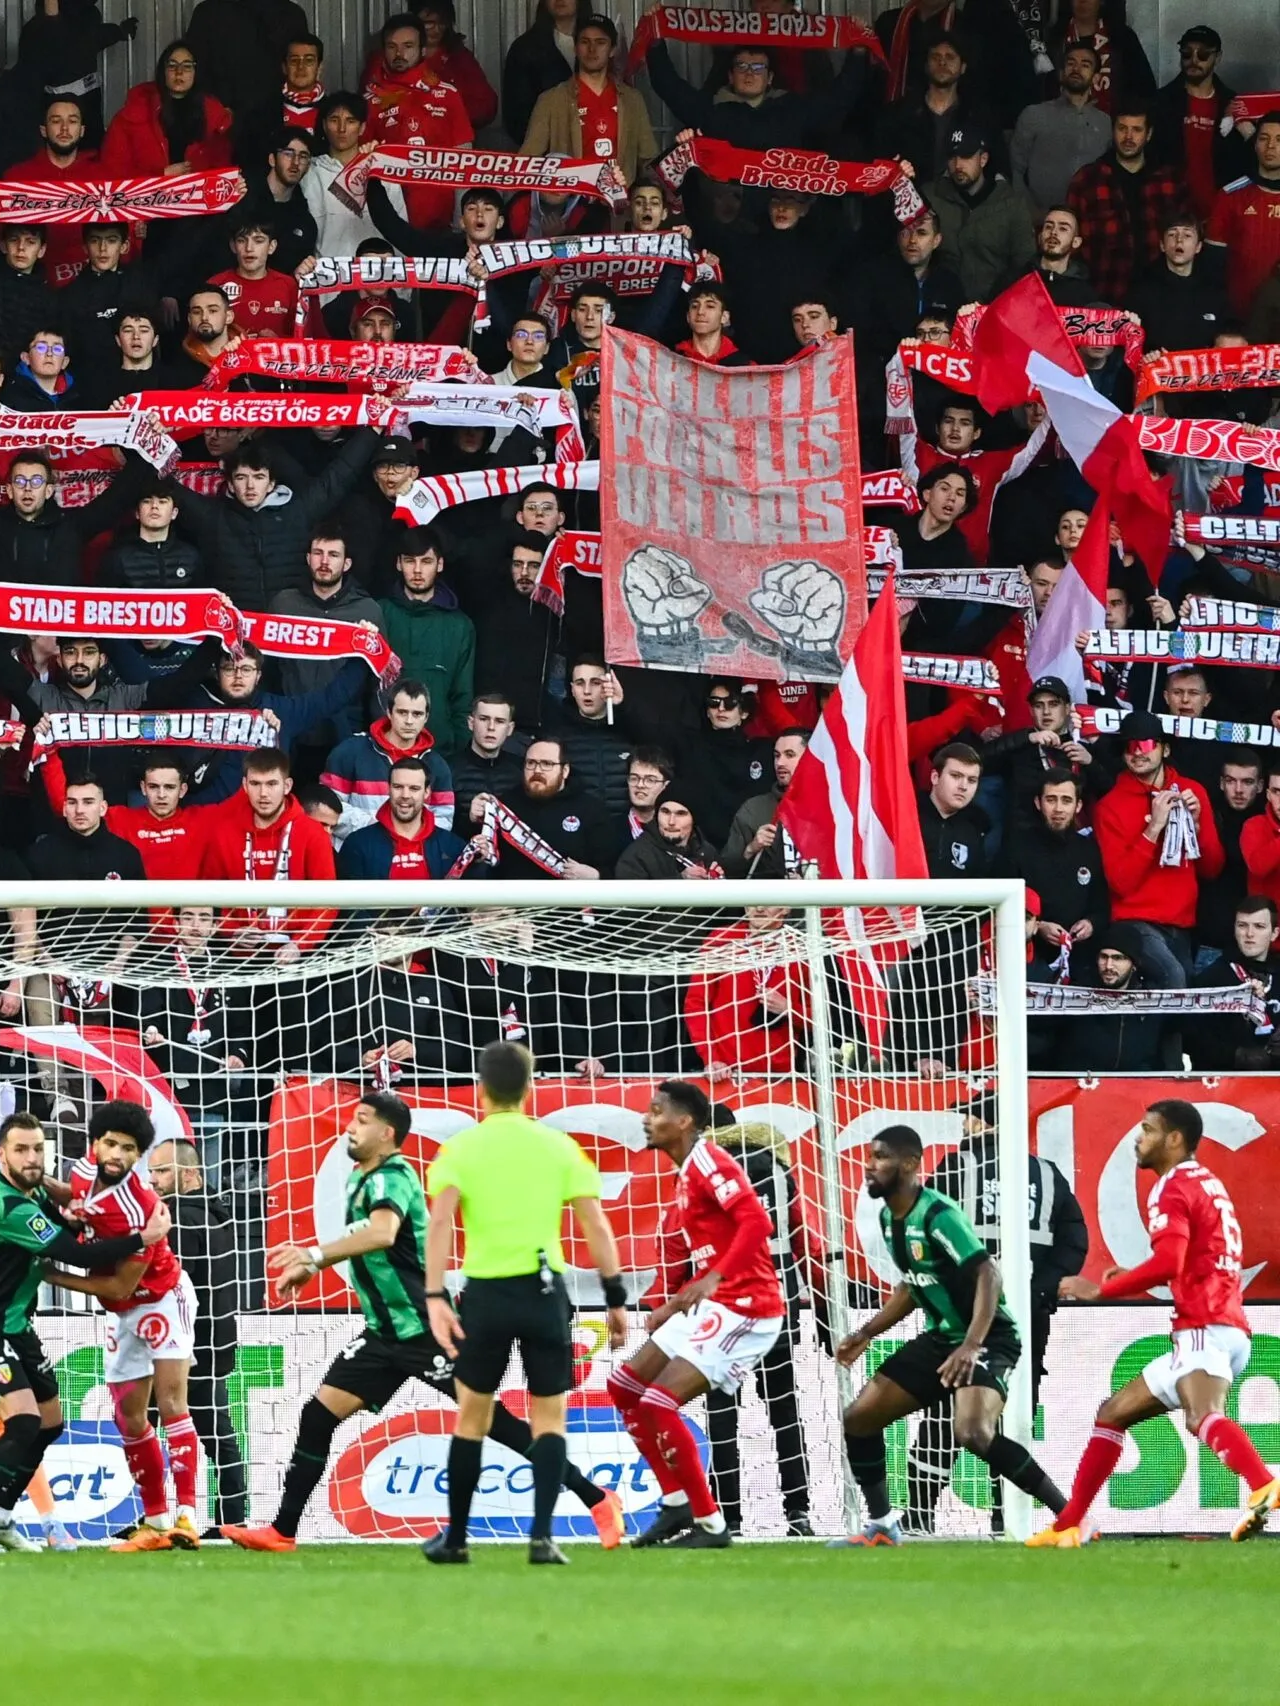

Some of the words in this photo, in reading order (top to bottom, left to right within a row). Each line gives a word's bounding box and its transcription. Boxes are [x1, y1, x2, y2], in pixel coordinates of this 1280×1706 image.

[667, 8, 762, 34] BRESTOIS
[768, 12, 827, 37] STADE
[408, 149, 561, 175] SUPPORTER
[761, 148, 841, 174] Stade
[384, 165, 406, 177] DU
[414, 168, 465, 182] STADE
[470, 171, 553, 187] BRESTOIS
[556, 174, 580, 188] 29
[740, 165, 848, 196] Brestois
[147, 404, 213, 423] STADE
[220, 403, 321, 423] BRESTOIS
[326, 404, 352, 422] 29
[616, 462, 847, 546] ULTRAS
[8, 596, 76, 624] STADE
[83, 600, 187, 628] BRESTOIS
[263, 620, 337, 648] BREST
